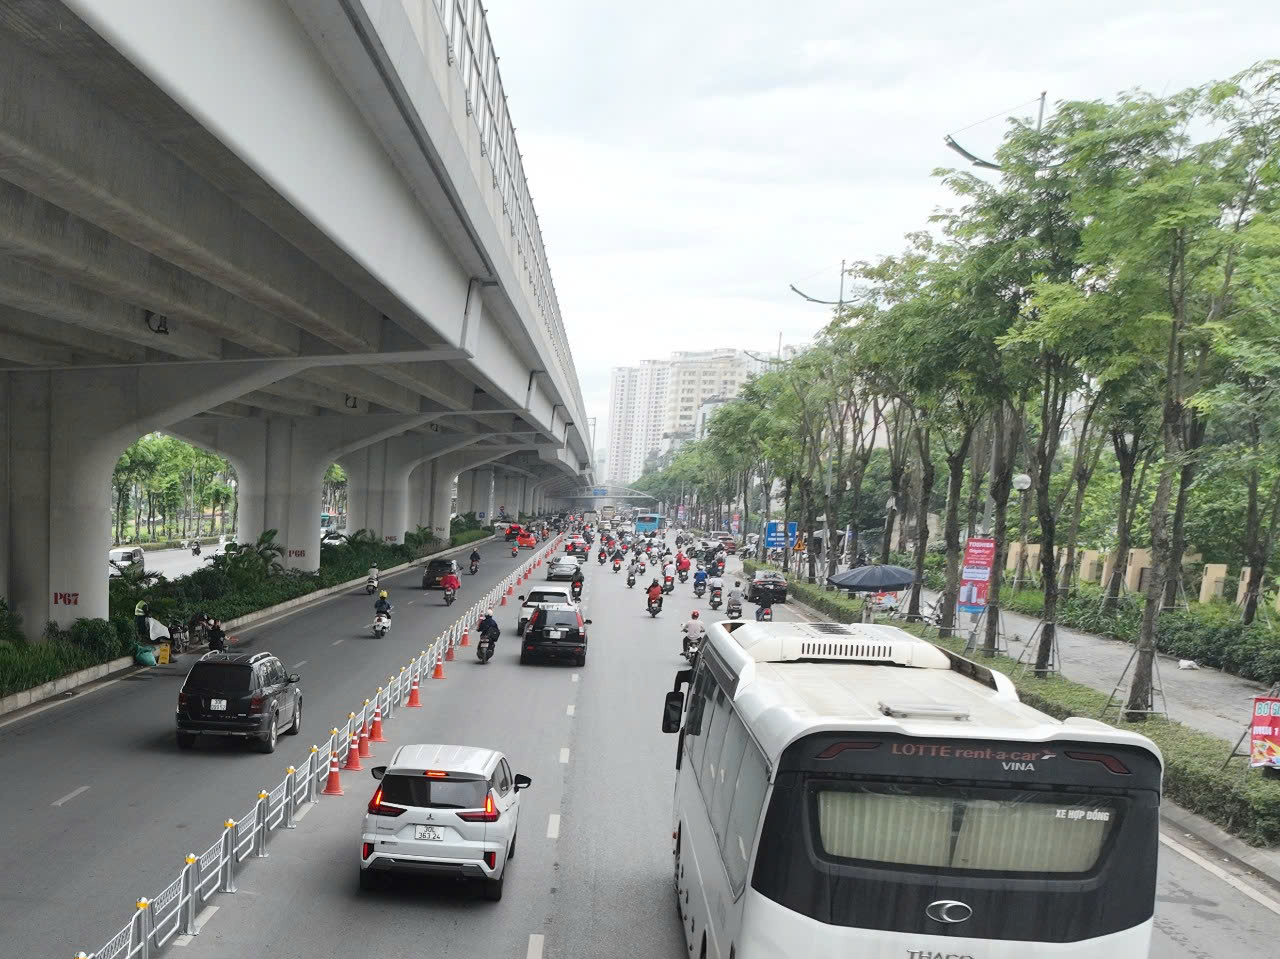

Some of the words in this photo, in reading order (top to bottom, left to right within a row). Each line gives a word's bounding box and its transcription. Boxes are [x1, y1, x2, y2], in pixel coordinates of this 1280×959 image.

[288, 549, 305, 557] P66
[53, 592, 79, 605] P67
[891, 743, 951, 757] LOTTE
[1002, 762, 1035, 771] VINA
[1055, 809, 1066, 818] XE
